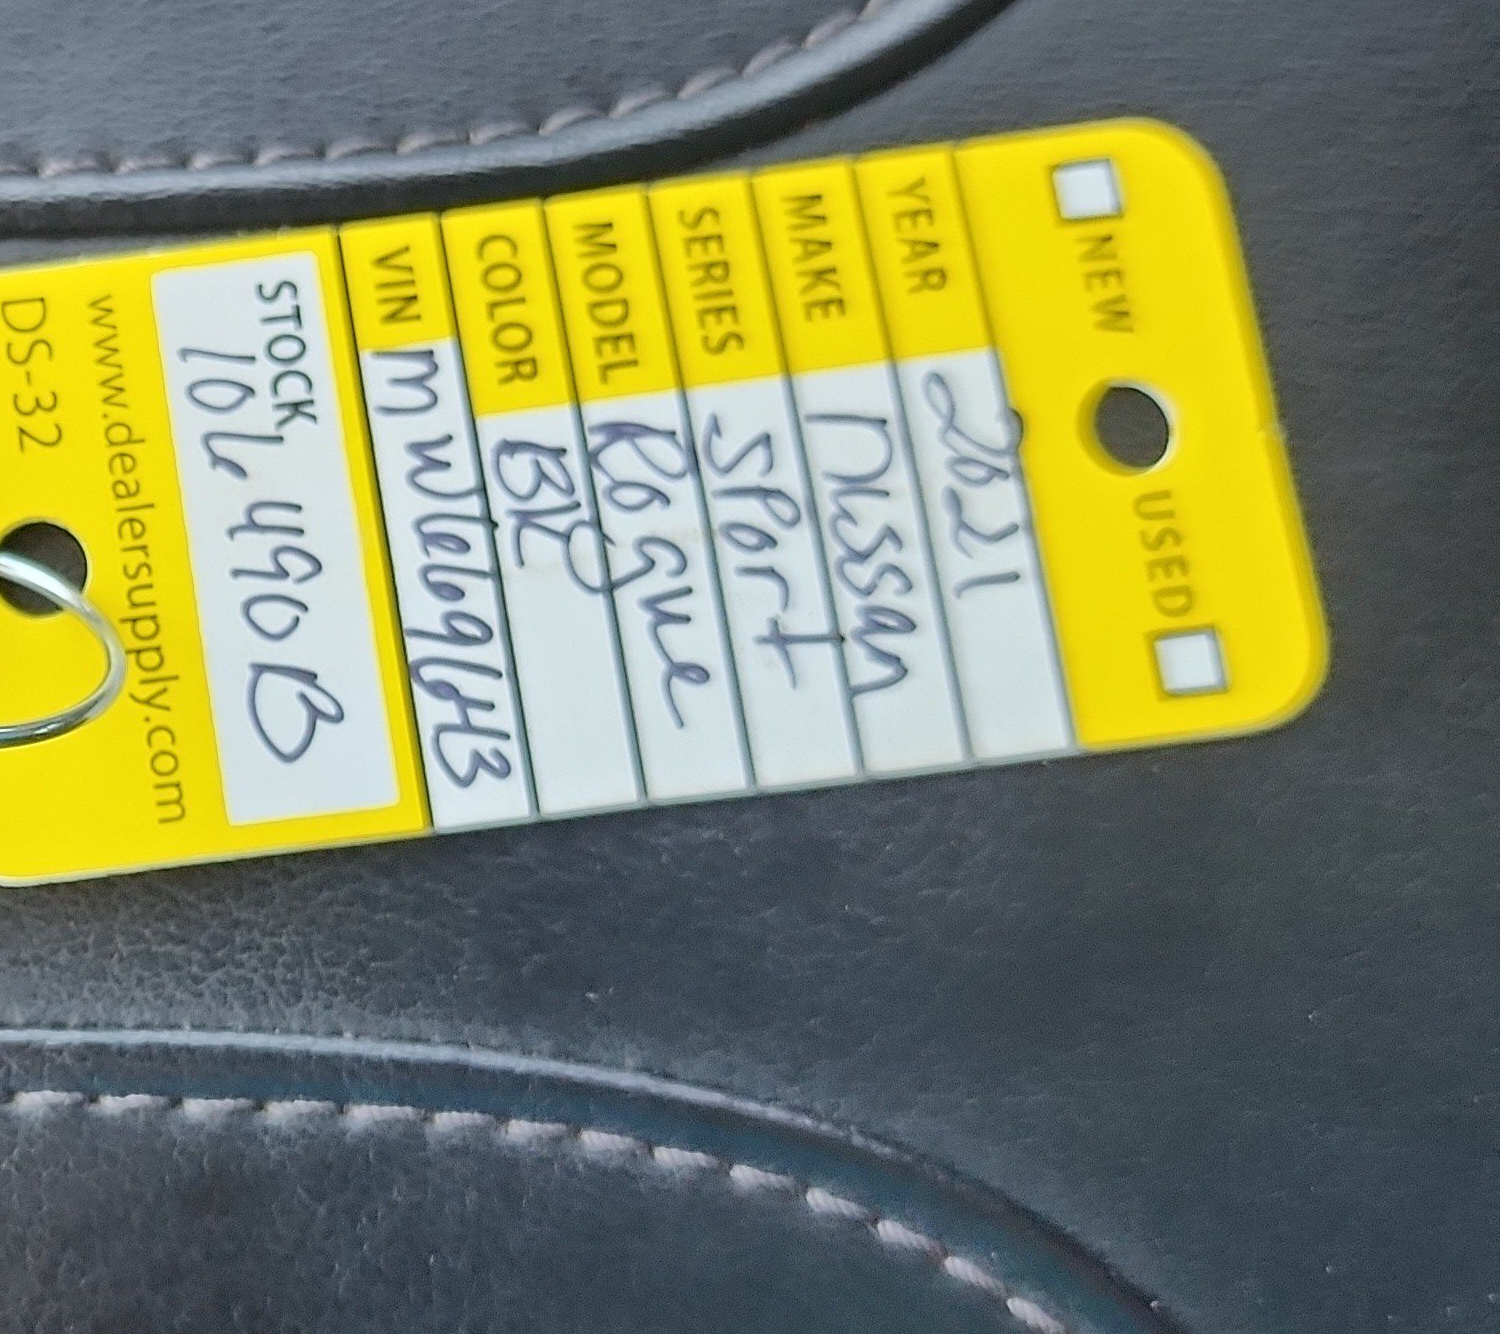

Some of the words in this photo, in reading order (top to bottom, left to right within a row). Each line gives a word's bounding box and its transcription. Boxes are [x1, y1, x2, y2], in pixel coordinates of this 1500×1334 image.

[369, 245, 422, 326] VIN
[475, 233, 539, 386] COLOR
[572, 221, 640, 385] MODEL
[677, 205, 745, 357] SERIES
[781, 193, 847, 323] MAKE
[886, 176, 949, 295] YEAR
[1076, 232, 1135, 335] NEW
[0, 295, 64, 455] DS-32
[254, 279, 318, 429] STOCK
[86, 292, 188, 826] www.dealersupply.com
[922, 370, 1020, 600] 2021
[1132, 488, 1196, 619] USED
[565, 419, 712, 730] Rogue
